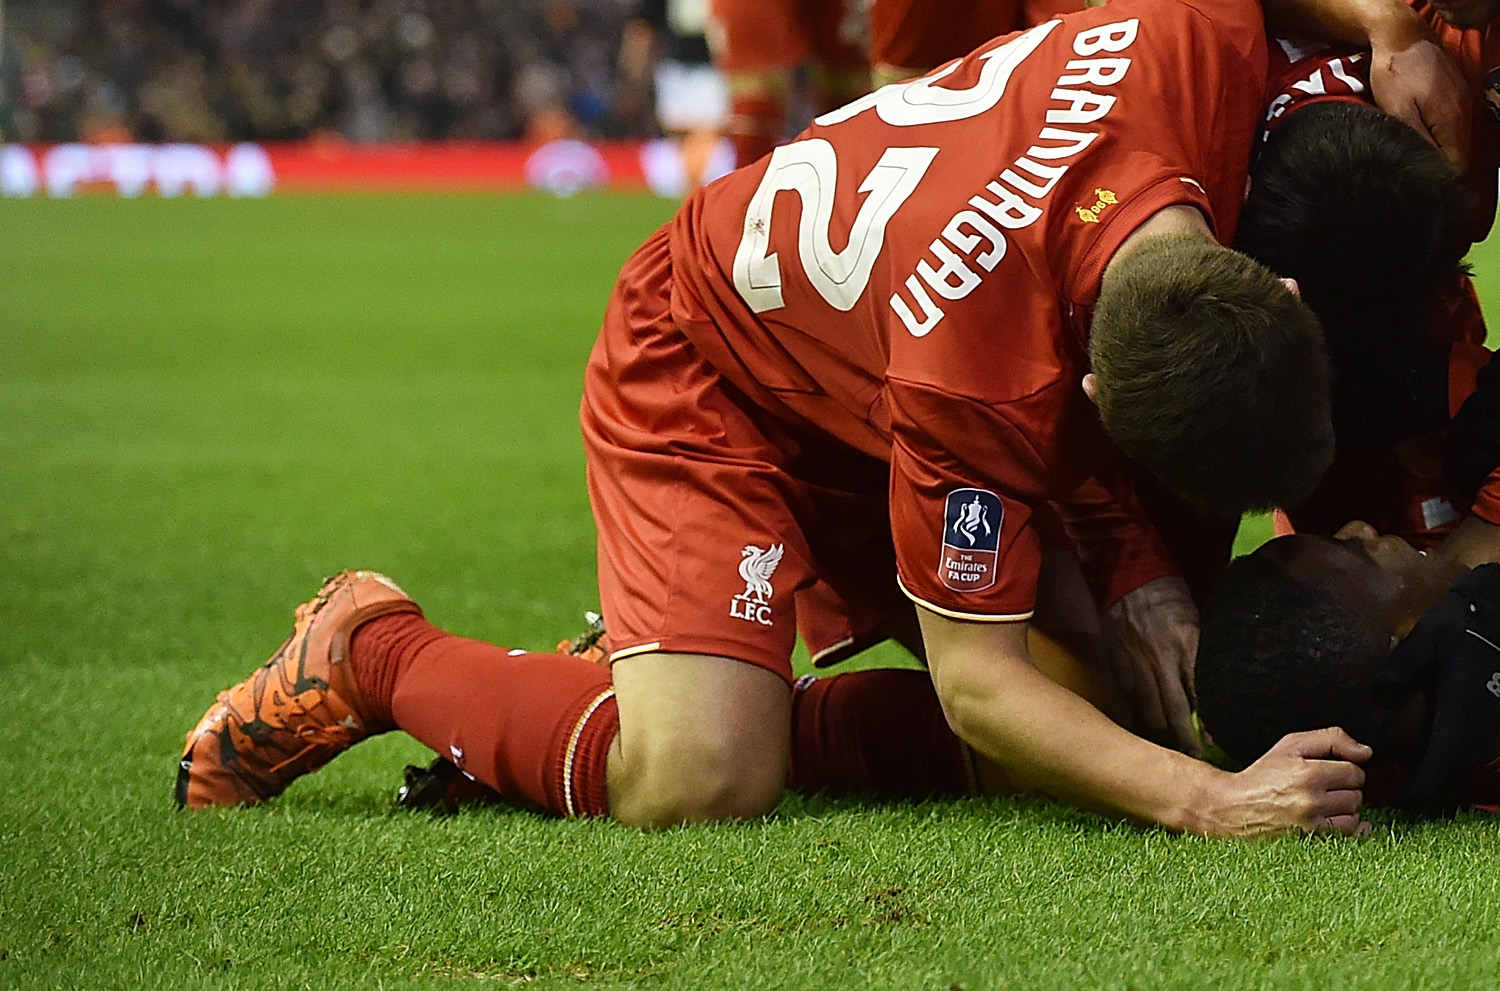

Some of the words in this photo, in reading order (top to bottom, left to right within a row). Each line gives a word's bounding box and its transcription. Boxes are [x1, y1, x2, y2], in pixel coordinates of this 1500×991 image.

[889, 19, 1139, 337] BRANNAGAN
[945, 556, 988, 573] Emirates
[948, 570, 960, 581] FA
[960, 572, 981, 582] CUP
[729, 598, 773, 626] L.F.C.
